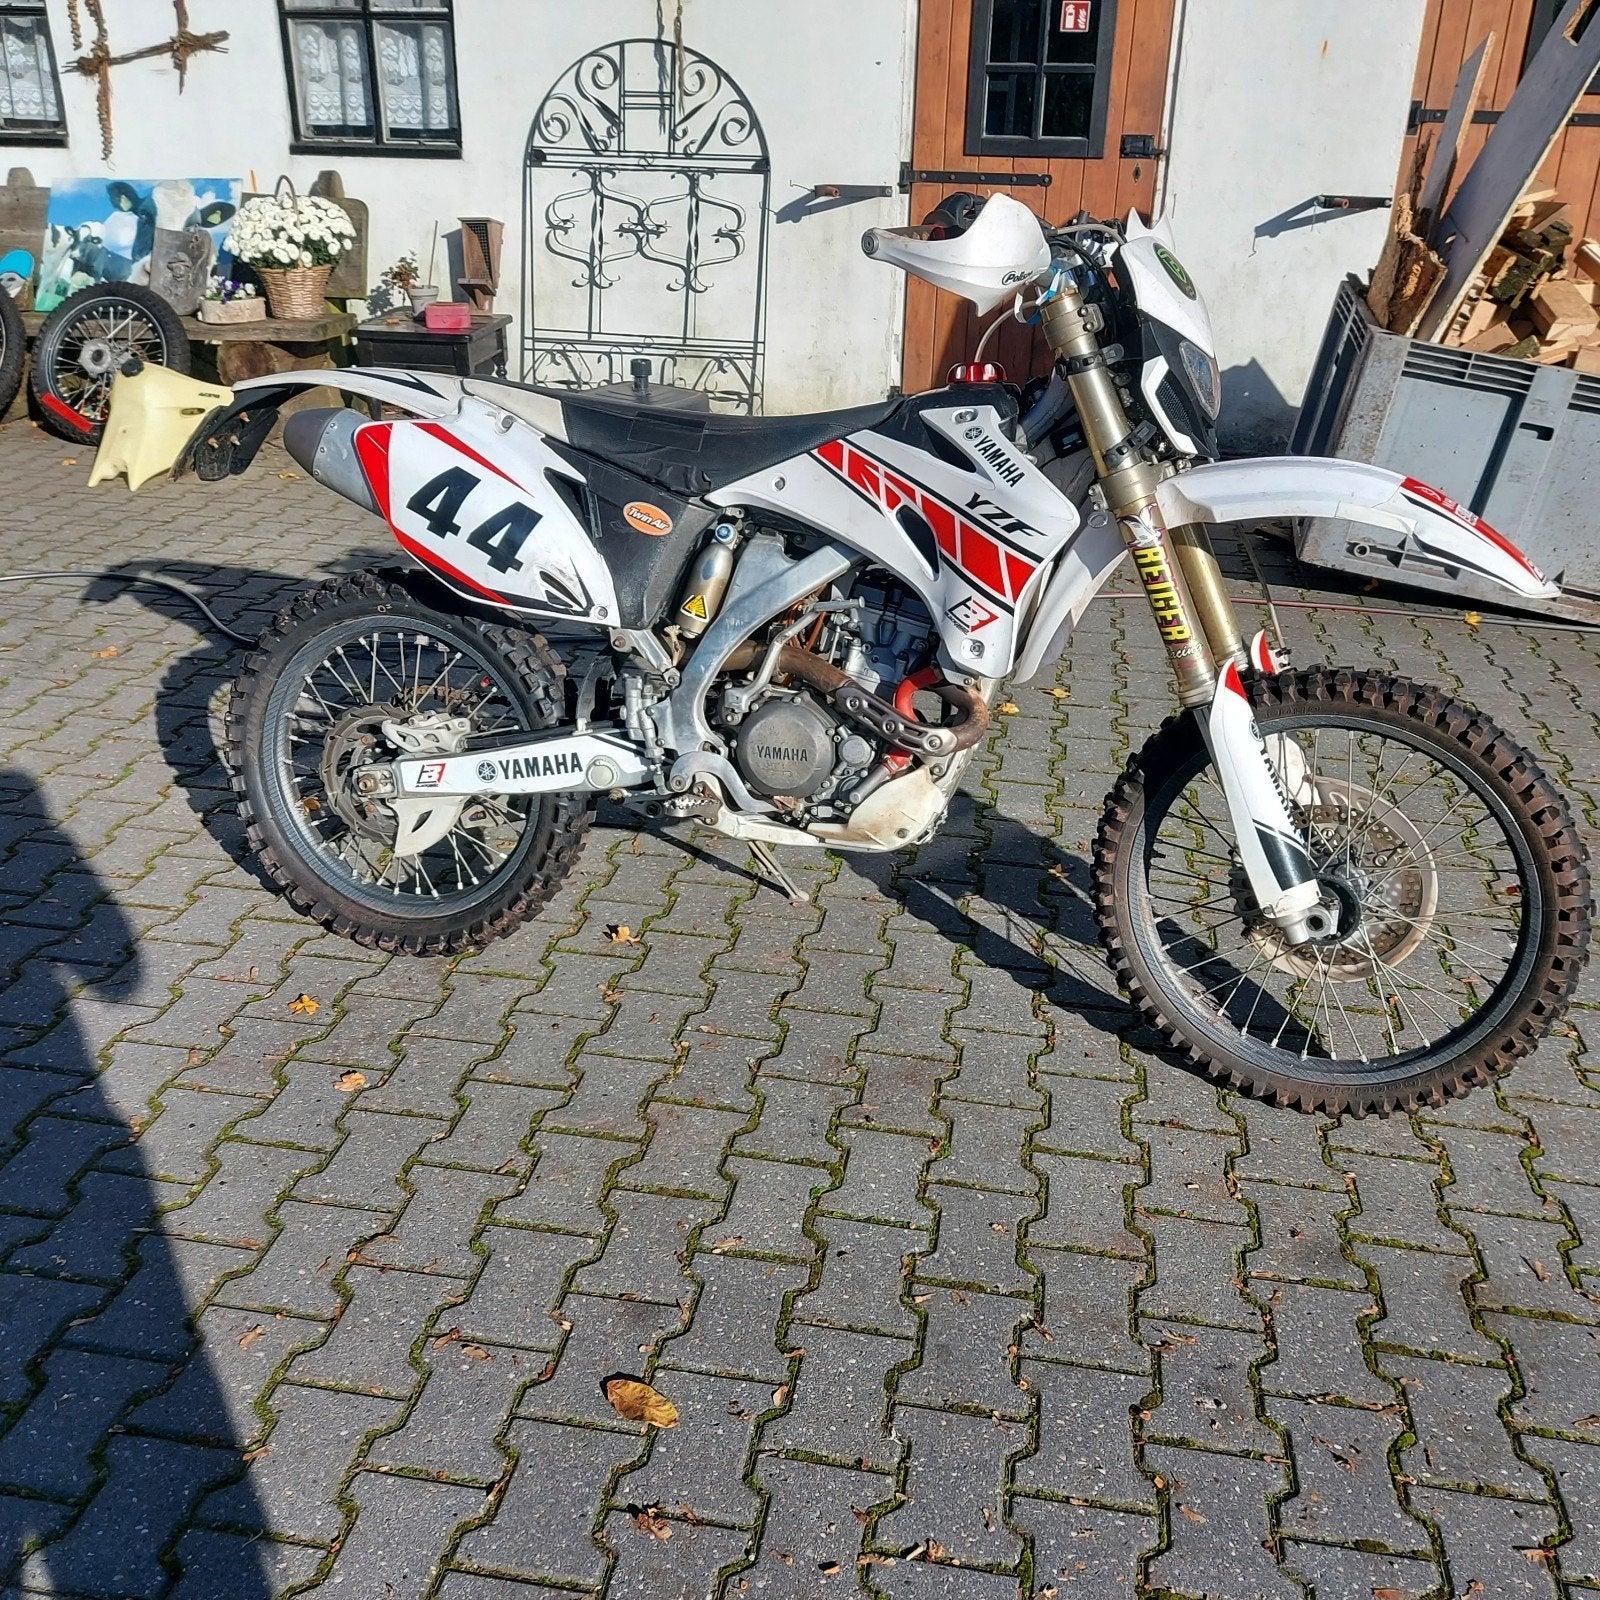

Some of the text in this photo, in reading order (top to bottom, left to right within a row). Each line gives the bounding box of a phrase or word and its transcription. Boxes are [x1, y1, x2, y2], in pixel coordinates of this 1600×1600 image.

[973, 435, 1026, 488] YAMAHA
[405, 466, 543, 574] 44
[628, 506, 670, 530] Twin Air
[965, 491, 1049, 536] YZF
[1134, 546, 1191, 641] REIGER
[498, 752, 584, 780] YAMAHA
[756, 744, 808, 762] YAMAHA
